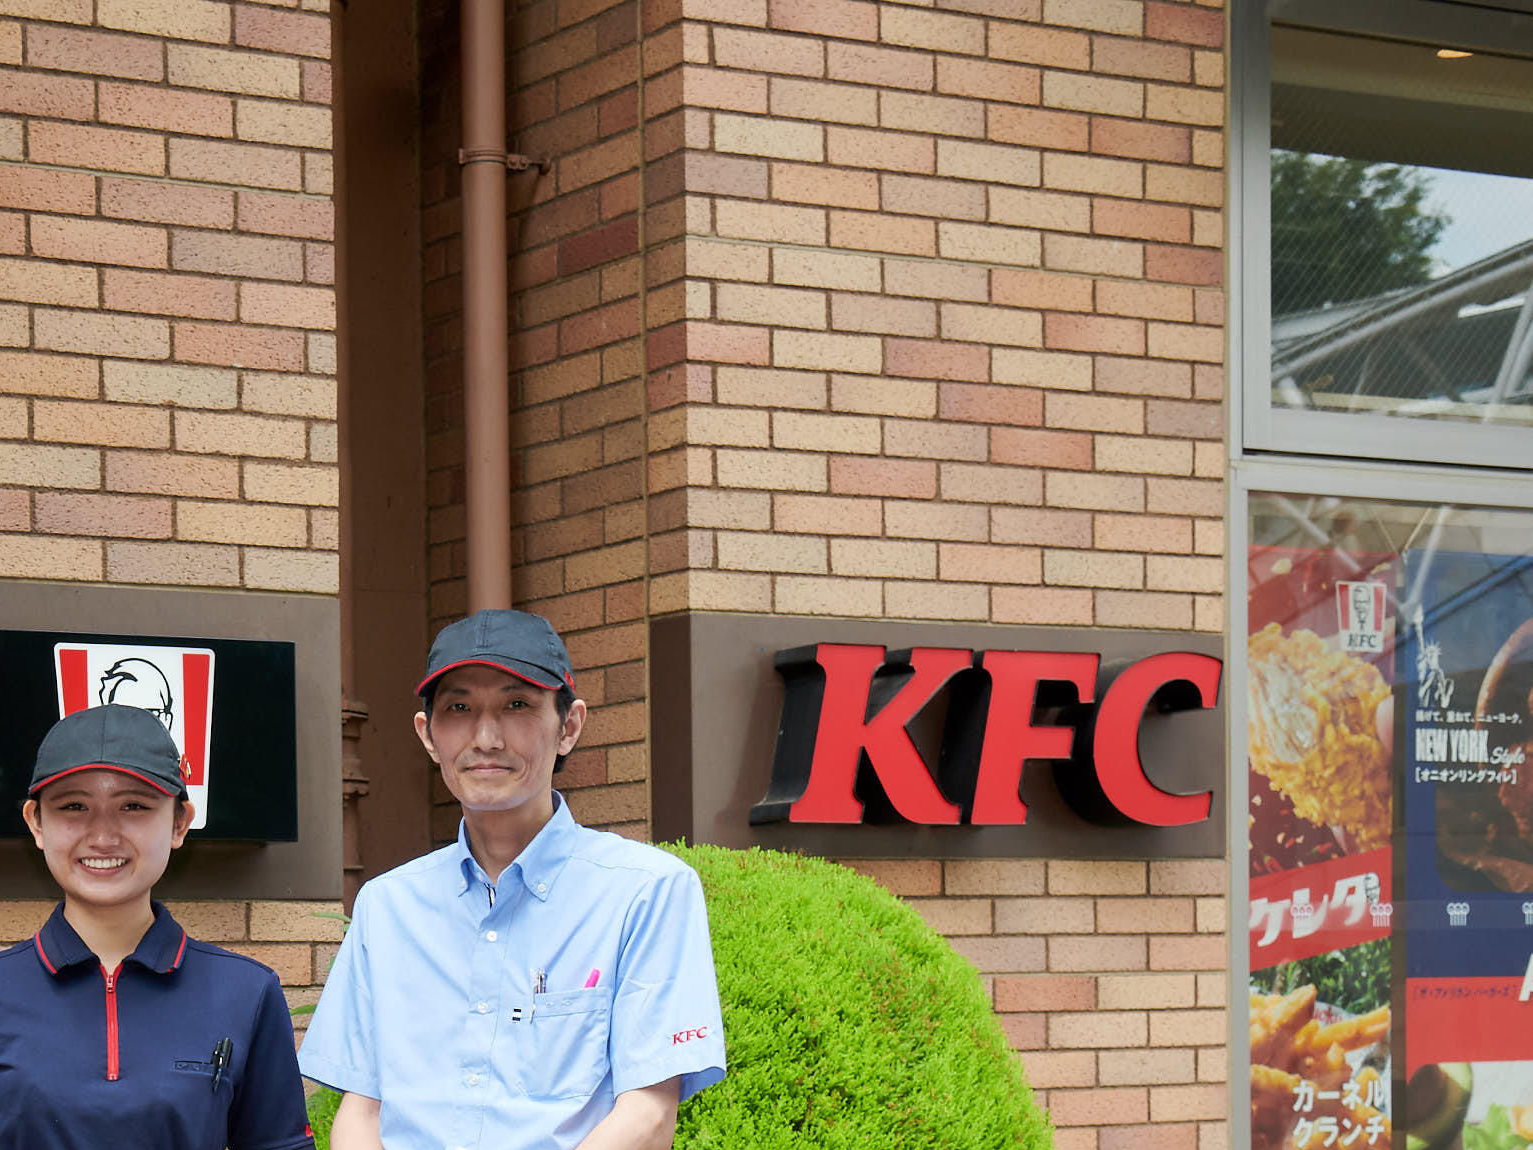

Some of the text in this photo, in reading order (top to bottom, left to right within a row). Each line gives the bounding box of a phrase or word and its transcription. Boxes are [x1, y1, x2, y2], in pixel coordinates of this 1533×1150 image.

[1348, 633, 1377, 648] KFC
[789, 642, 1223, 827] KFC
[1416, 728, 1525, 769] NEW YORK Style
[672, 1026, 708, 1046] KFC
[1292, 1079, 1383, 1113] カーネル
[1293, 1115, 1385, 1148] クランチ
